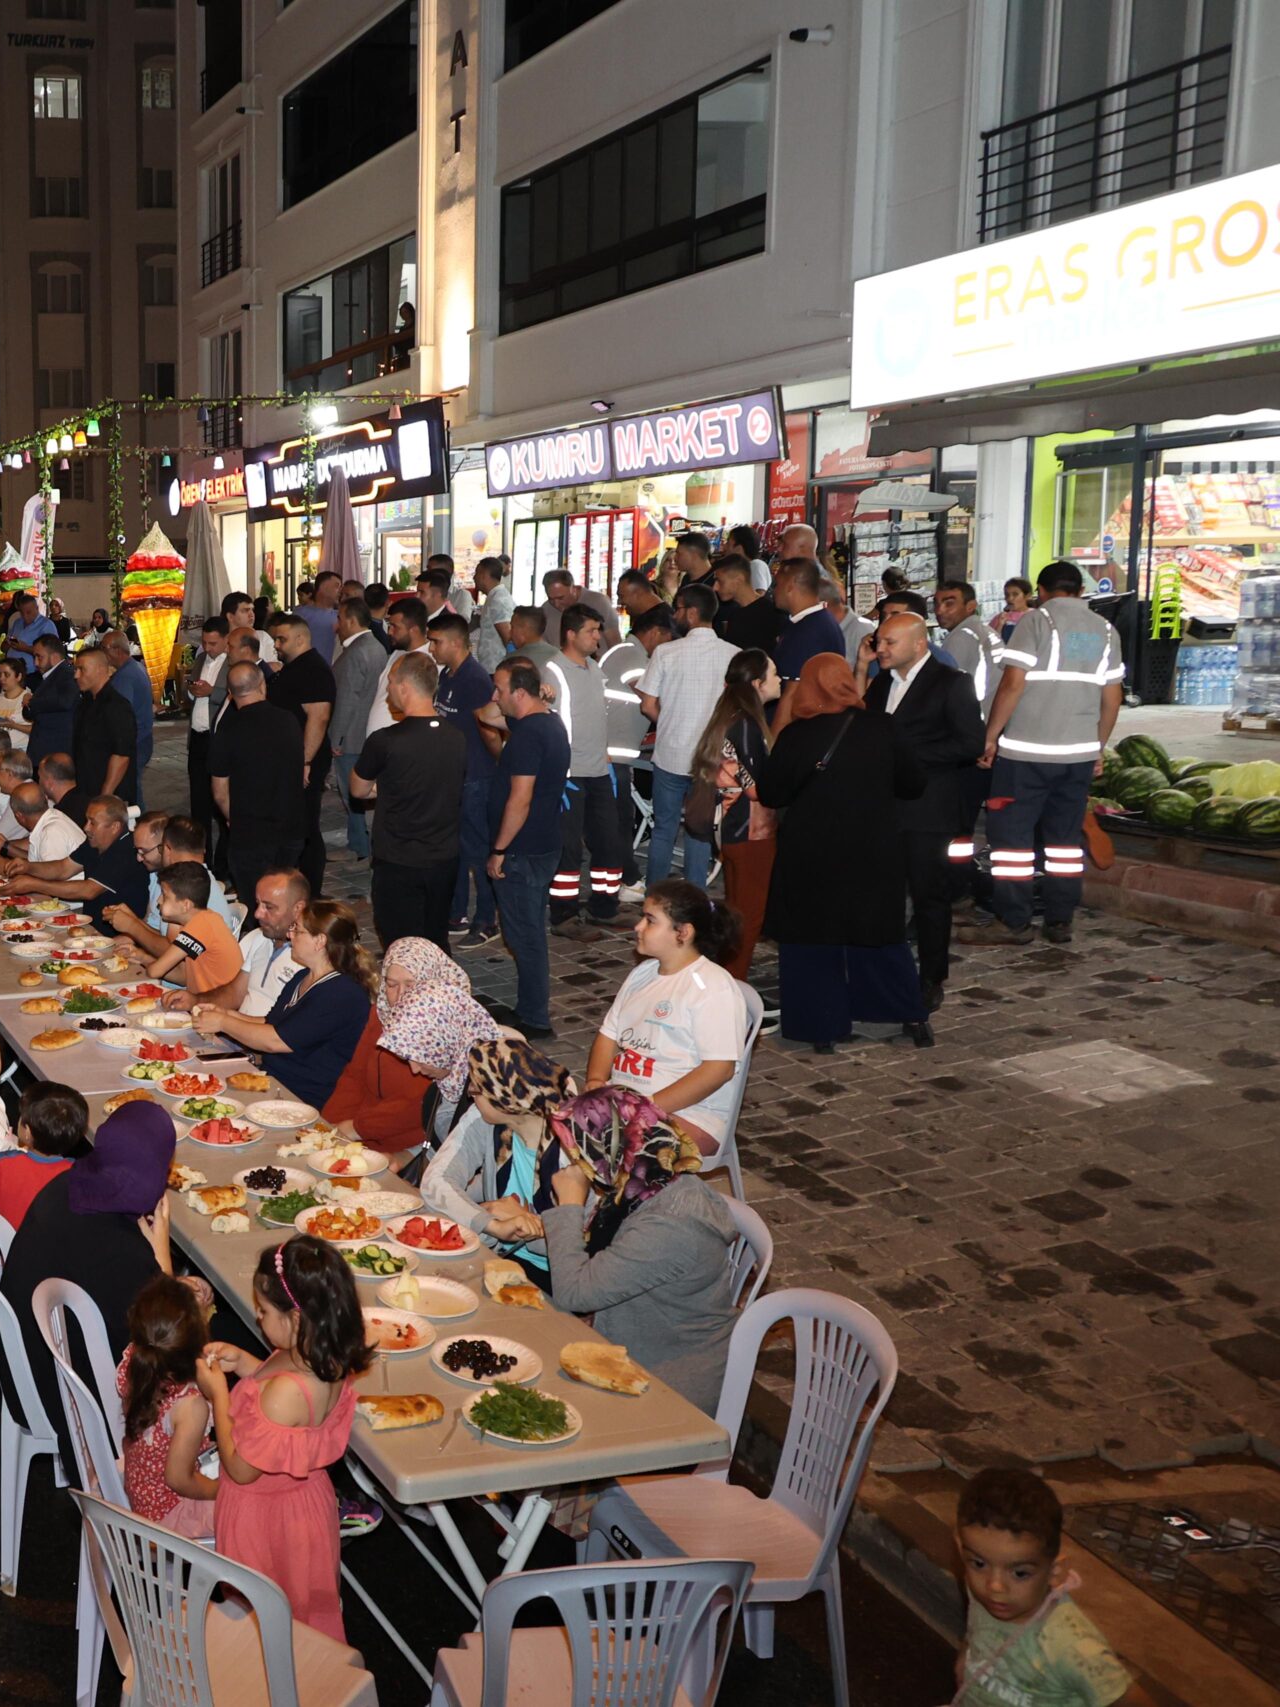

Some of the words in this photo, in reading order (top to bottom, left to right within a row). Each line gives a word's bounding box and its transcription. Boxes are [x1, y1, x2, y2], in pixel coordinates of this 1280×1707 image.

[952, 241, 1090, 328] ERAS
[1116, 199, 1280, 287] GRO
[511, 428, 605, 486] KUMRU
[614, 403, 743, 473] MARKET
[180, 479, 202, 507] ÖREN
[205, 466, 245, 502] ELEKTRİK
